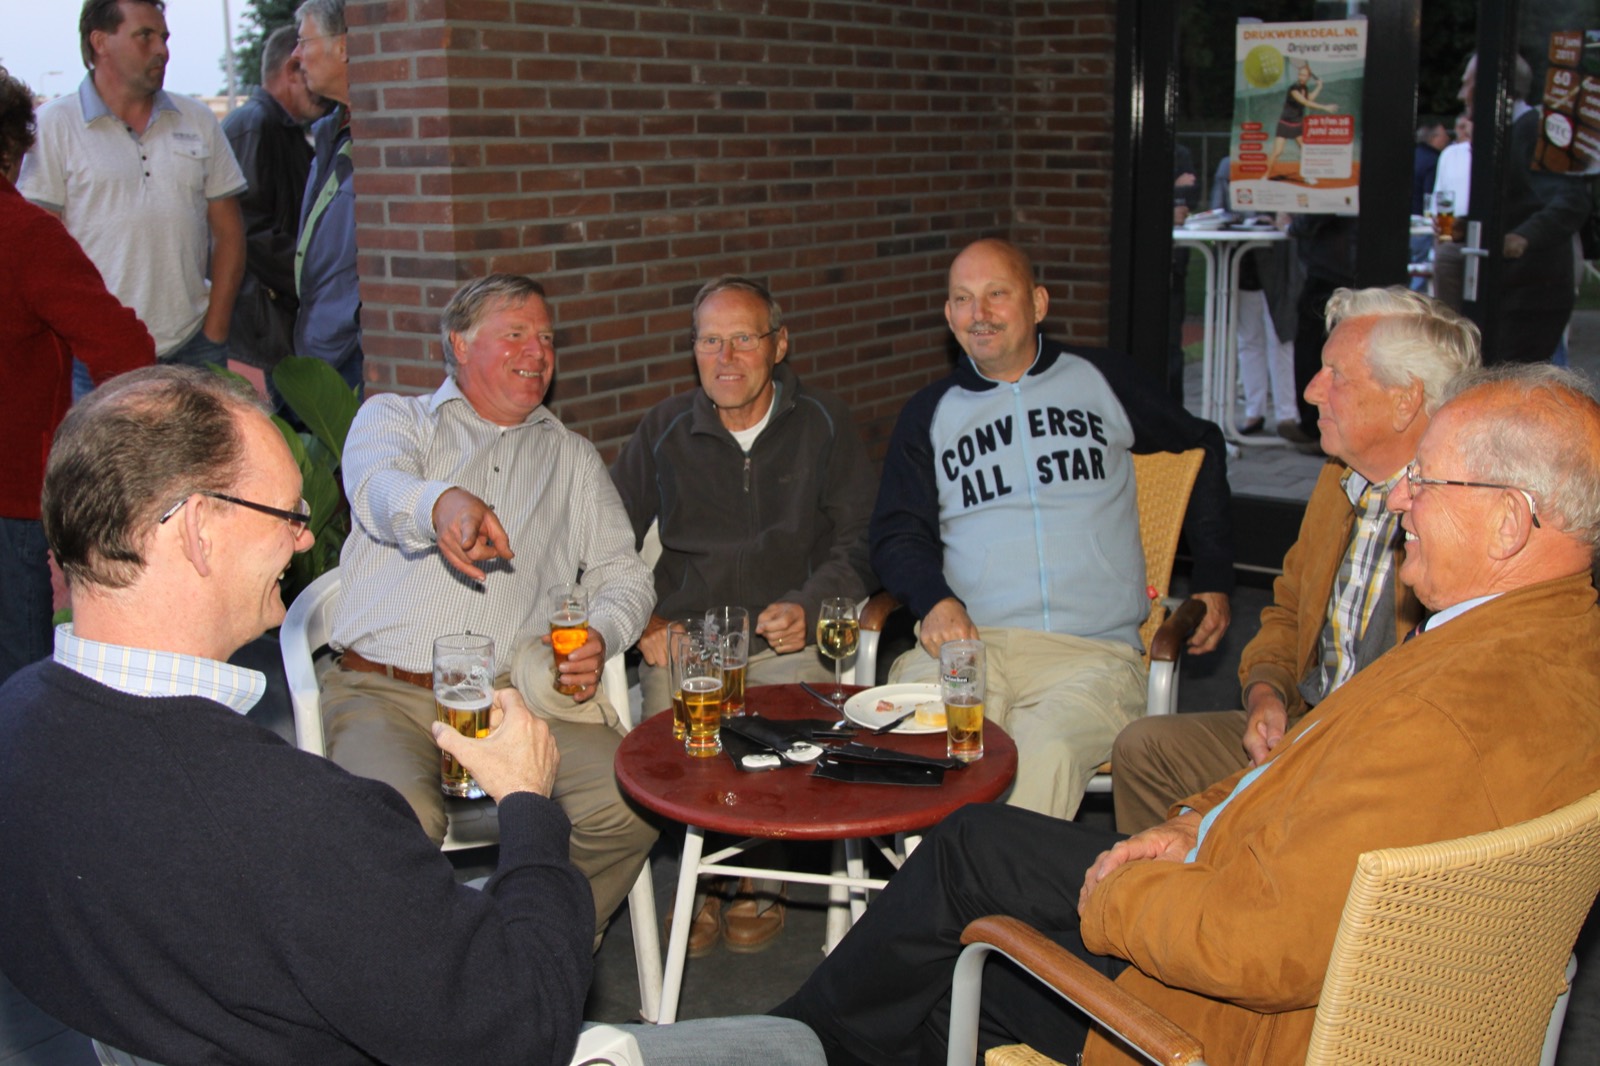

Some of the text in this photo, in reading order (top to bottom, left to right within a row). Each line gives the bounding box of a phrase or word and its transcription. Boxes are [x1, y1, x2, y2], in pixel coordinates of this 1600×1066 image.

[1243, 27, 1359, 40] DRUKWERKDEAL.NL
[1332, 43, 1358, 53] open
[1553, 71, 1571, 87] 60
[1306, 126, 1327, 137] juni
[1547, 122, 1569, 139] DTC
[961, 447, 1106, 508] ALL STAR
